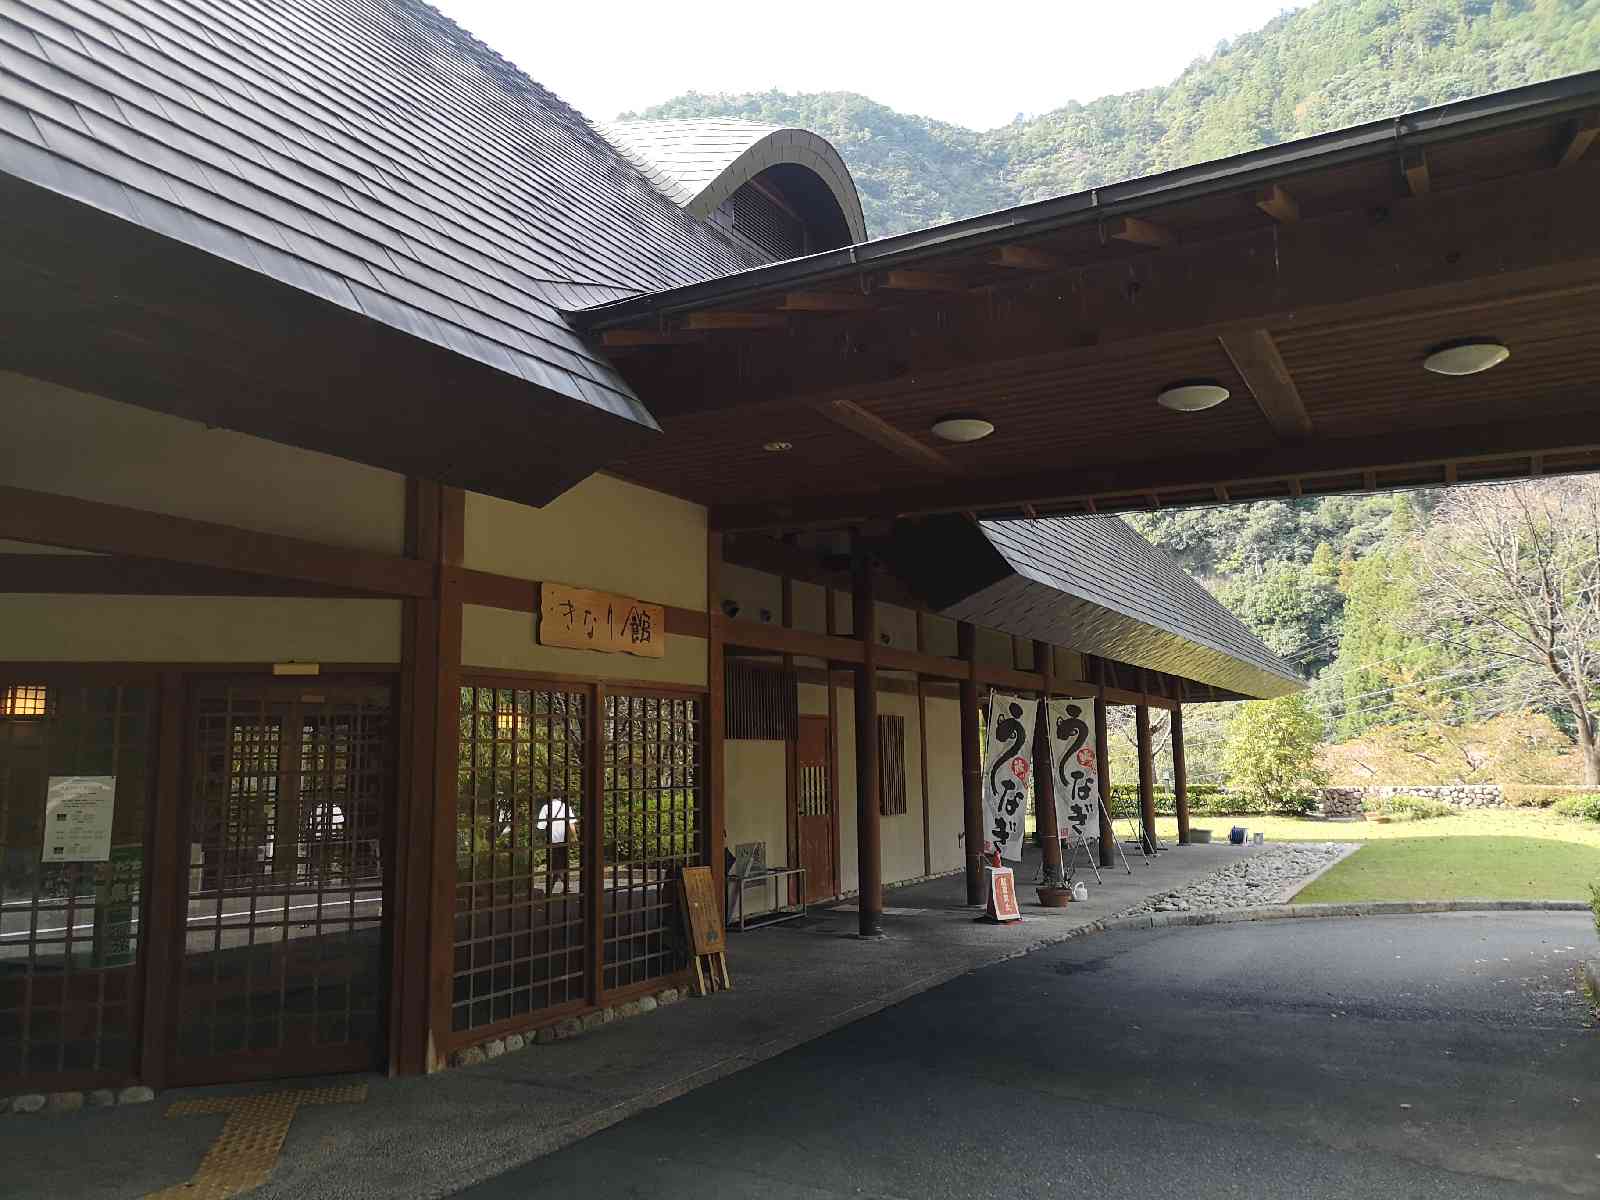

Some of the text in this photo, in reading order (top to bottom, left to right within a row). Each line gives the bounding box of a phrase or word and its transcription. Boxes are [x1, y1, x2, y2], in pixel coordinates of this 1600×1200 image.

[559, 600, 651, 643] きなり館
[990, 702, 1025, 852] うなぎ
[1057, 704, 1094, 835] うなぎ
